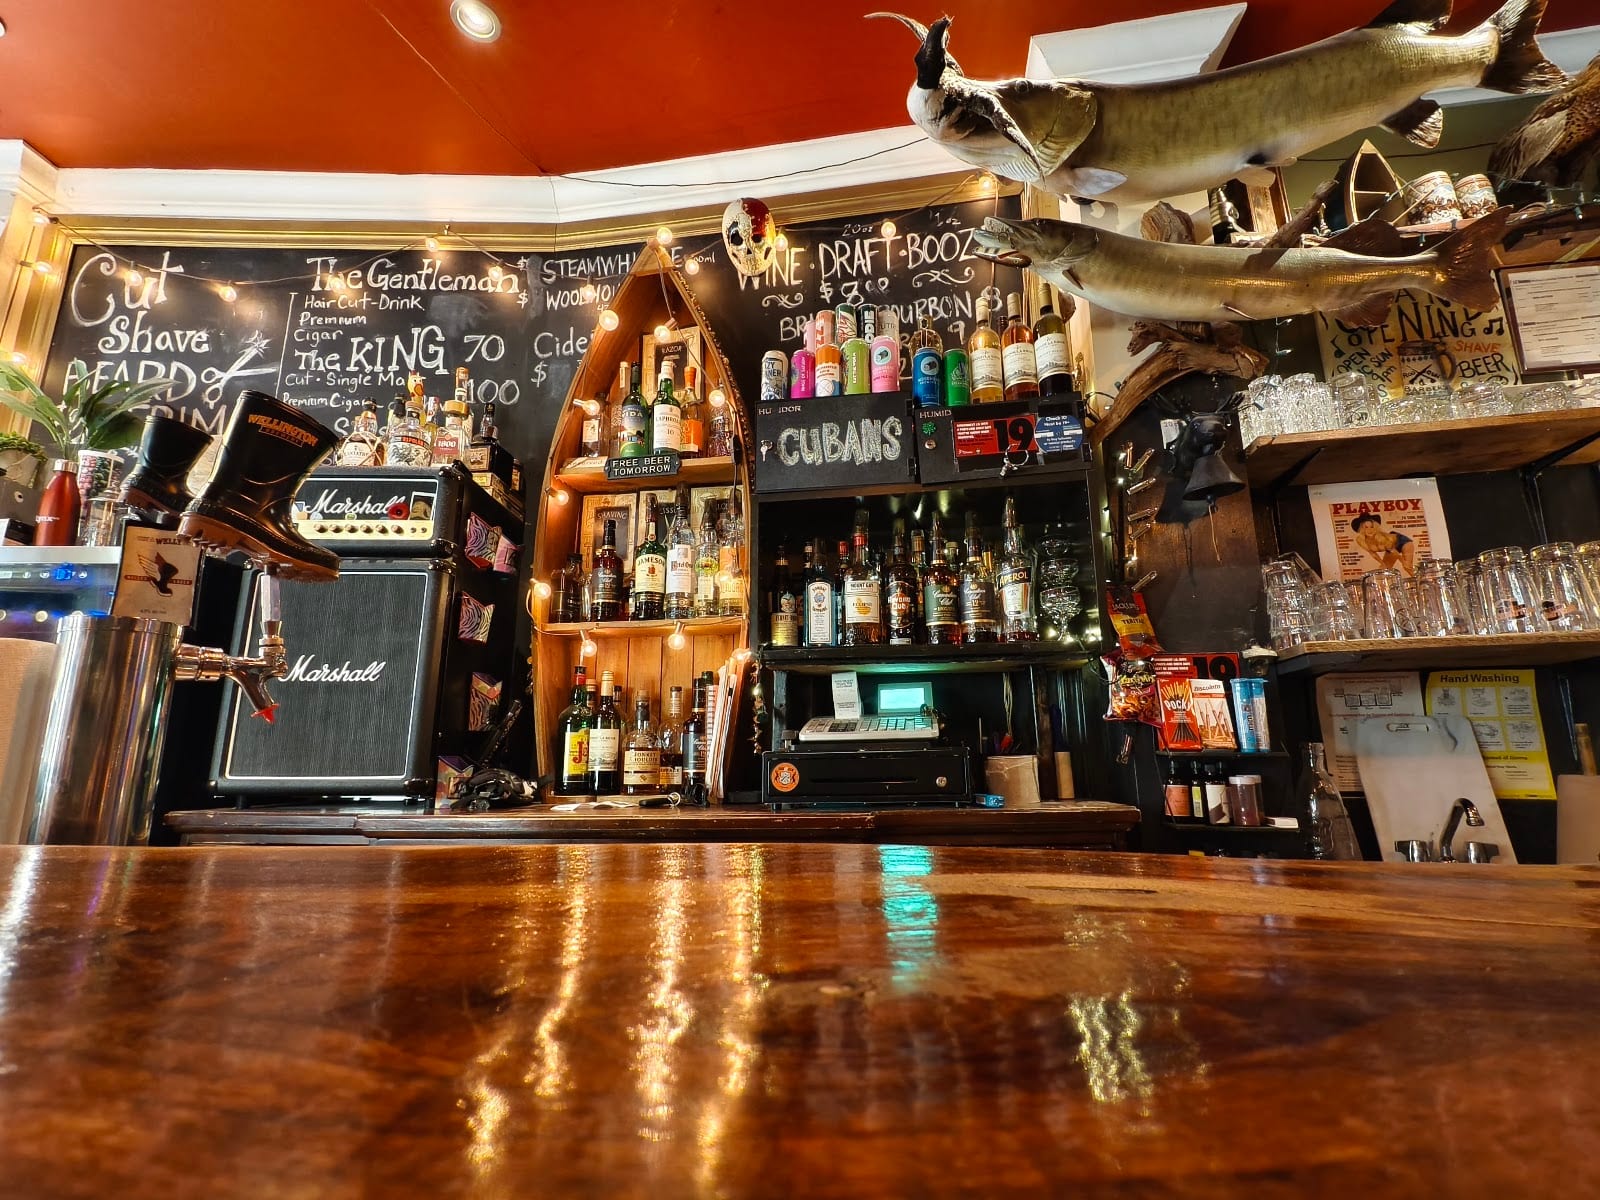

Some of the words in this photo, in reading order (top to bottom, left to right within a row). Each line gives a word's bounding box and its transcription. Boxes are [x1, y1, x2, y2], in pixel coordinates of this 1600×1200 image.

[818, 235, 903, 279] DRAFT
[907, 229, 981, 270] BOOZ
[306, 256, 363, 292] The
[366, 257, 520, 294] Gentleman
[71, 251, 184, 327] Cut
[98, 310, 210, 354] Shave
[299, 312, 367, 326] Premium
[294, 328, 343, 348] Cigar
[294, 349, 341, 373] The
[346, 325, 449, 376] KING
[463, 335, 506, 363] 70
[533, 327, 595, 359] Cide
[1454, 341, 1501, 353] SHAVE
[1336, 347, 1372, 374] OPEN
[1369, 347, 1393, 368] SUN
[1456, 353, 1511, 378] BEER
[285, 373, 311, 387] Cut
[326, 372, 372, 393] Single
[463, 378, 520, 406] 100
[282, 392, 328, 407] Premium
[127, 404, 228, 437] RIM
[248, 414, 318, 447] WELLINGTON
[777, 416, 903, 467] CUBANS
[993, 416, 1035, 452] 19
[612, 459, 638, 468] FREE
[644, 456, 671, 465] BEER
[613, 465, 671, 477] TOMORROW
[1331, 499, 1422, 515] PLAYBOY
[637, 554, 665, 566] JAMESON
[999, 572, 1029, 586] APEROL
[278, 654, 387, 682] Marshall
[1440, 674, 1468, 683] Hand
[1470, 674, 1520, 684] Washing
